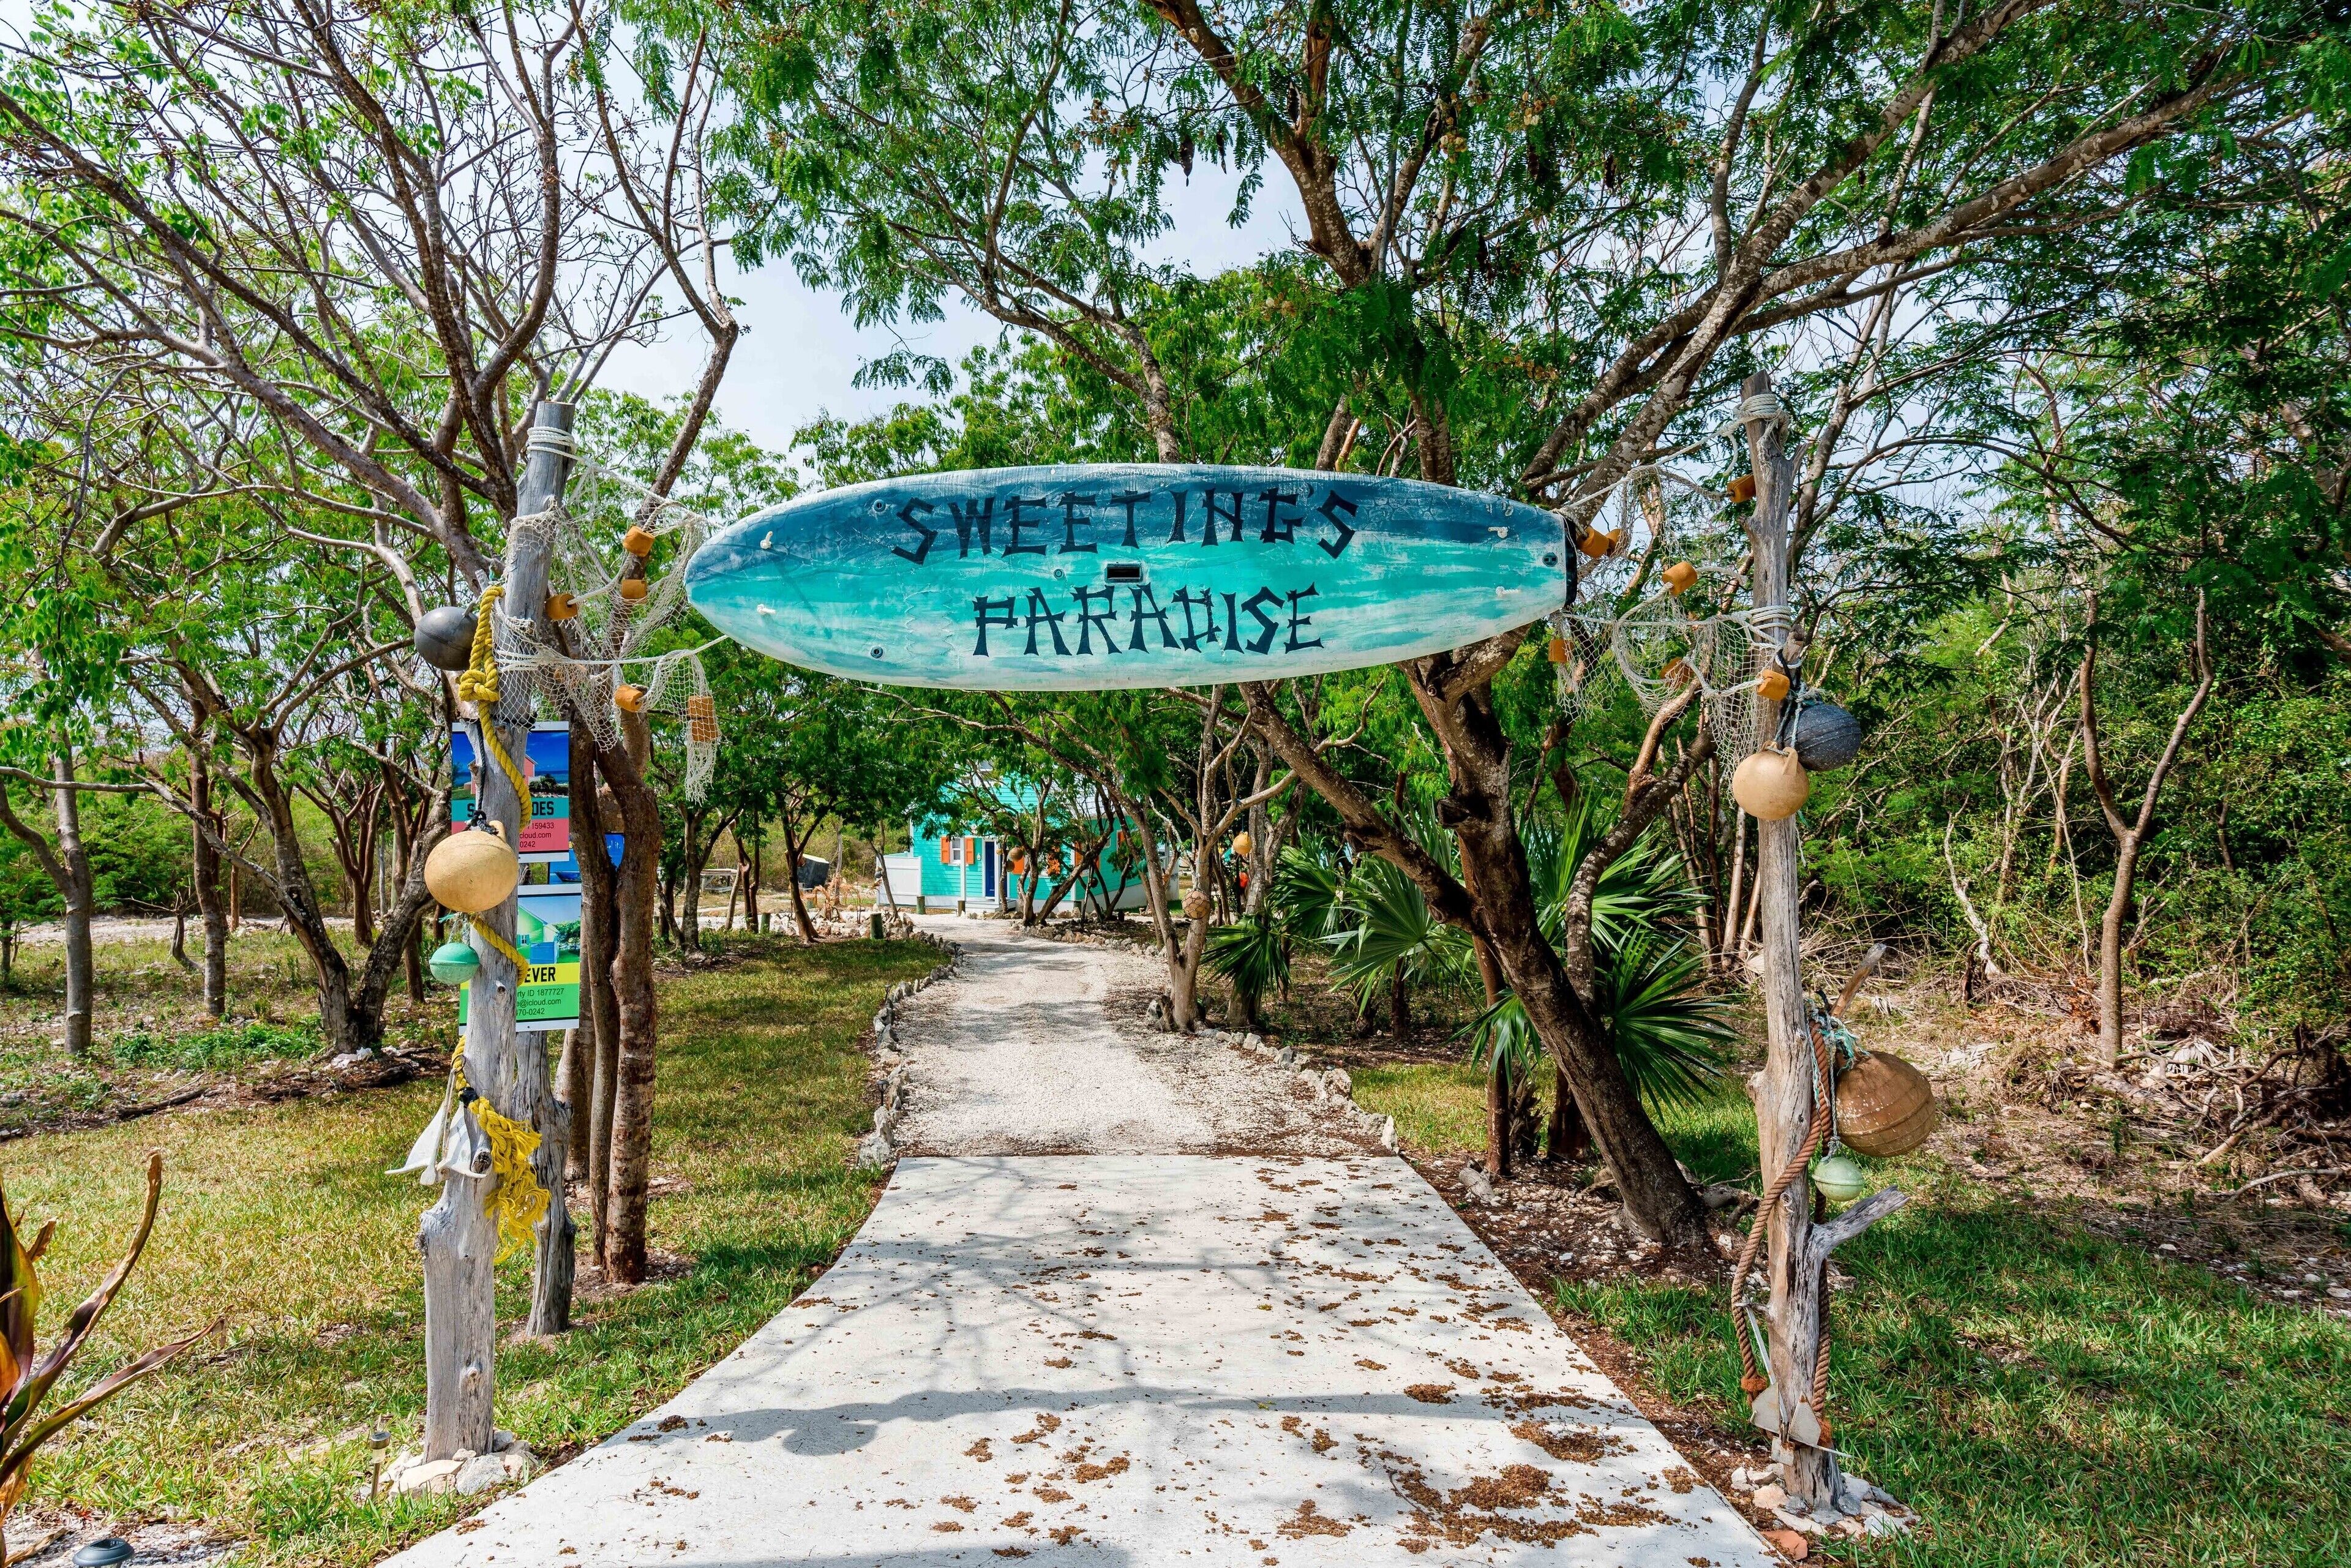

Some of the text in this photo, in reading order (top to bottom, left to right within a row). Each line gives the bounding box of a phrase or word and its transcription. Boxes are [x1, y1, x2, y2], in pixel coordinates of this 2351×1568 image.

[891, 482, 1359, 565] SWEETING'S
[972, 582, 1324, 657] PARADISE
[537, 988, 564, 996] 1877727
[516, 999, 561, 1008] e@icloud.com
[516, 1008, 546, 1016] 70-0242
